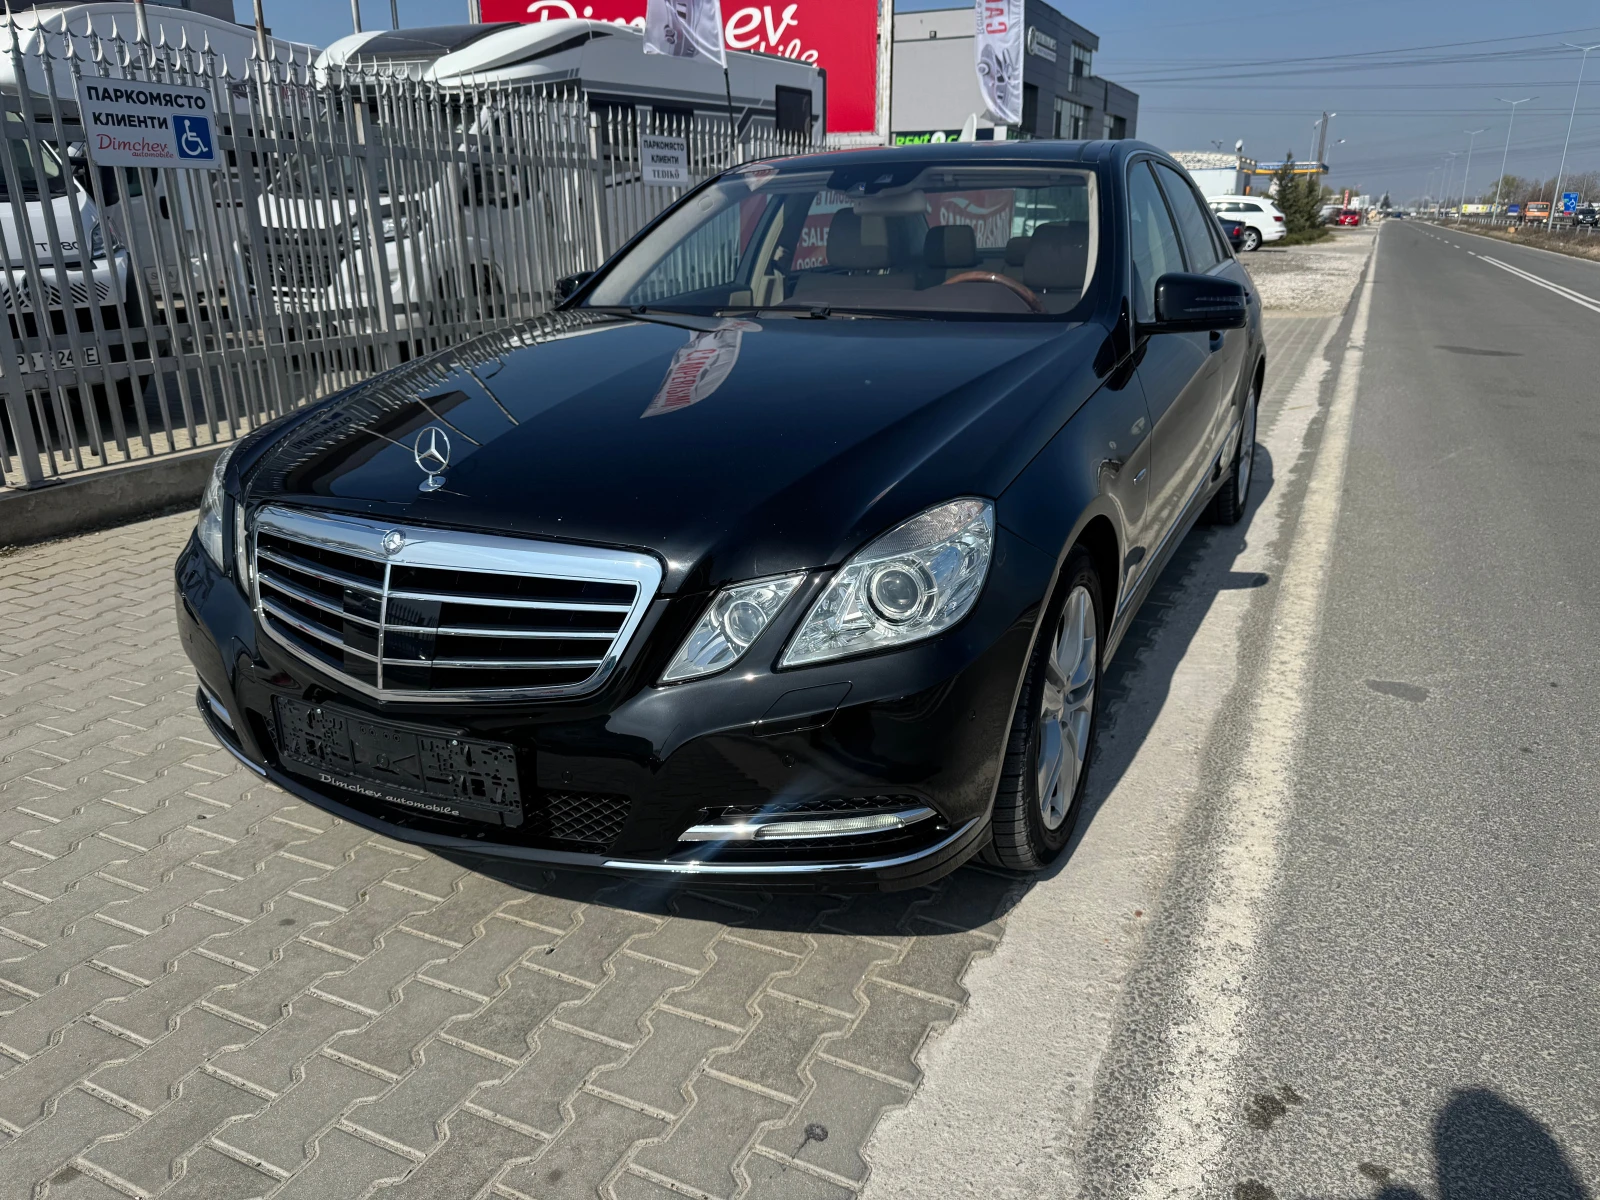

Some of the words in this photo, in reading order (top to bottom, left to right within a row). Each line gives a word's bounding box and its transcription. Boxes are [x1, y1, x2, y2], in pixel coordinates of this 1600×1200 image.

[86, 86, 206, 110] ПАРКОМЯСТО
[92, 112, 169, 130] КЛИЕНТИ
[96, 133, 168, 153] Dimchev
[643, 140, 685, 152] ПАРКОМЯСТО
[651, 154, 680, 164] КЛИЕНТИ
[318, 773, 382, 798] Dimchev
[385, 795, 460, 816] automobile
